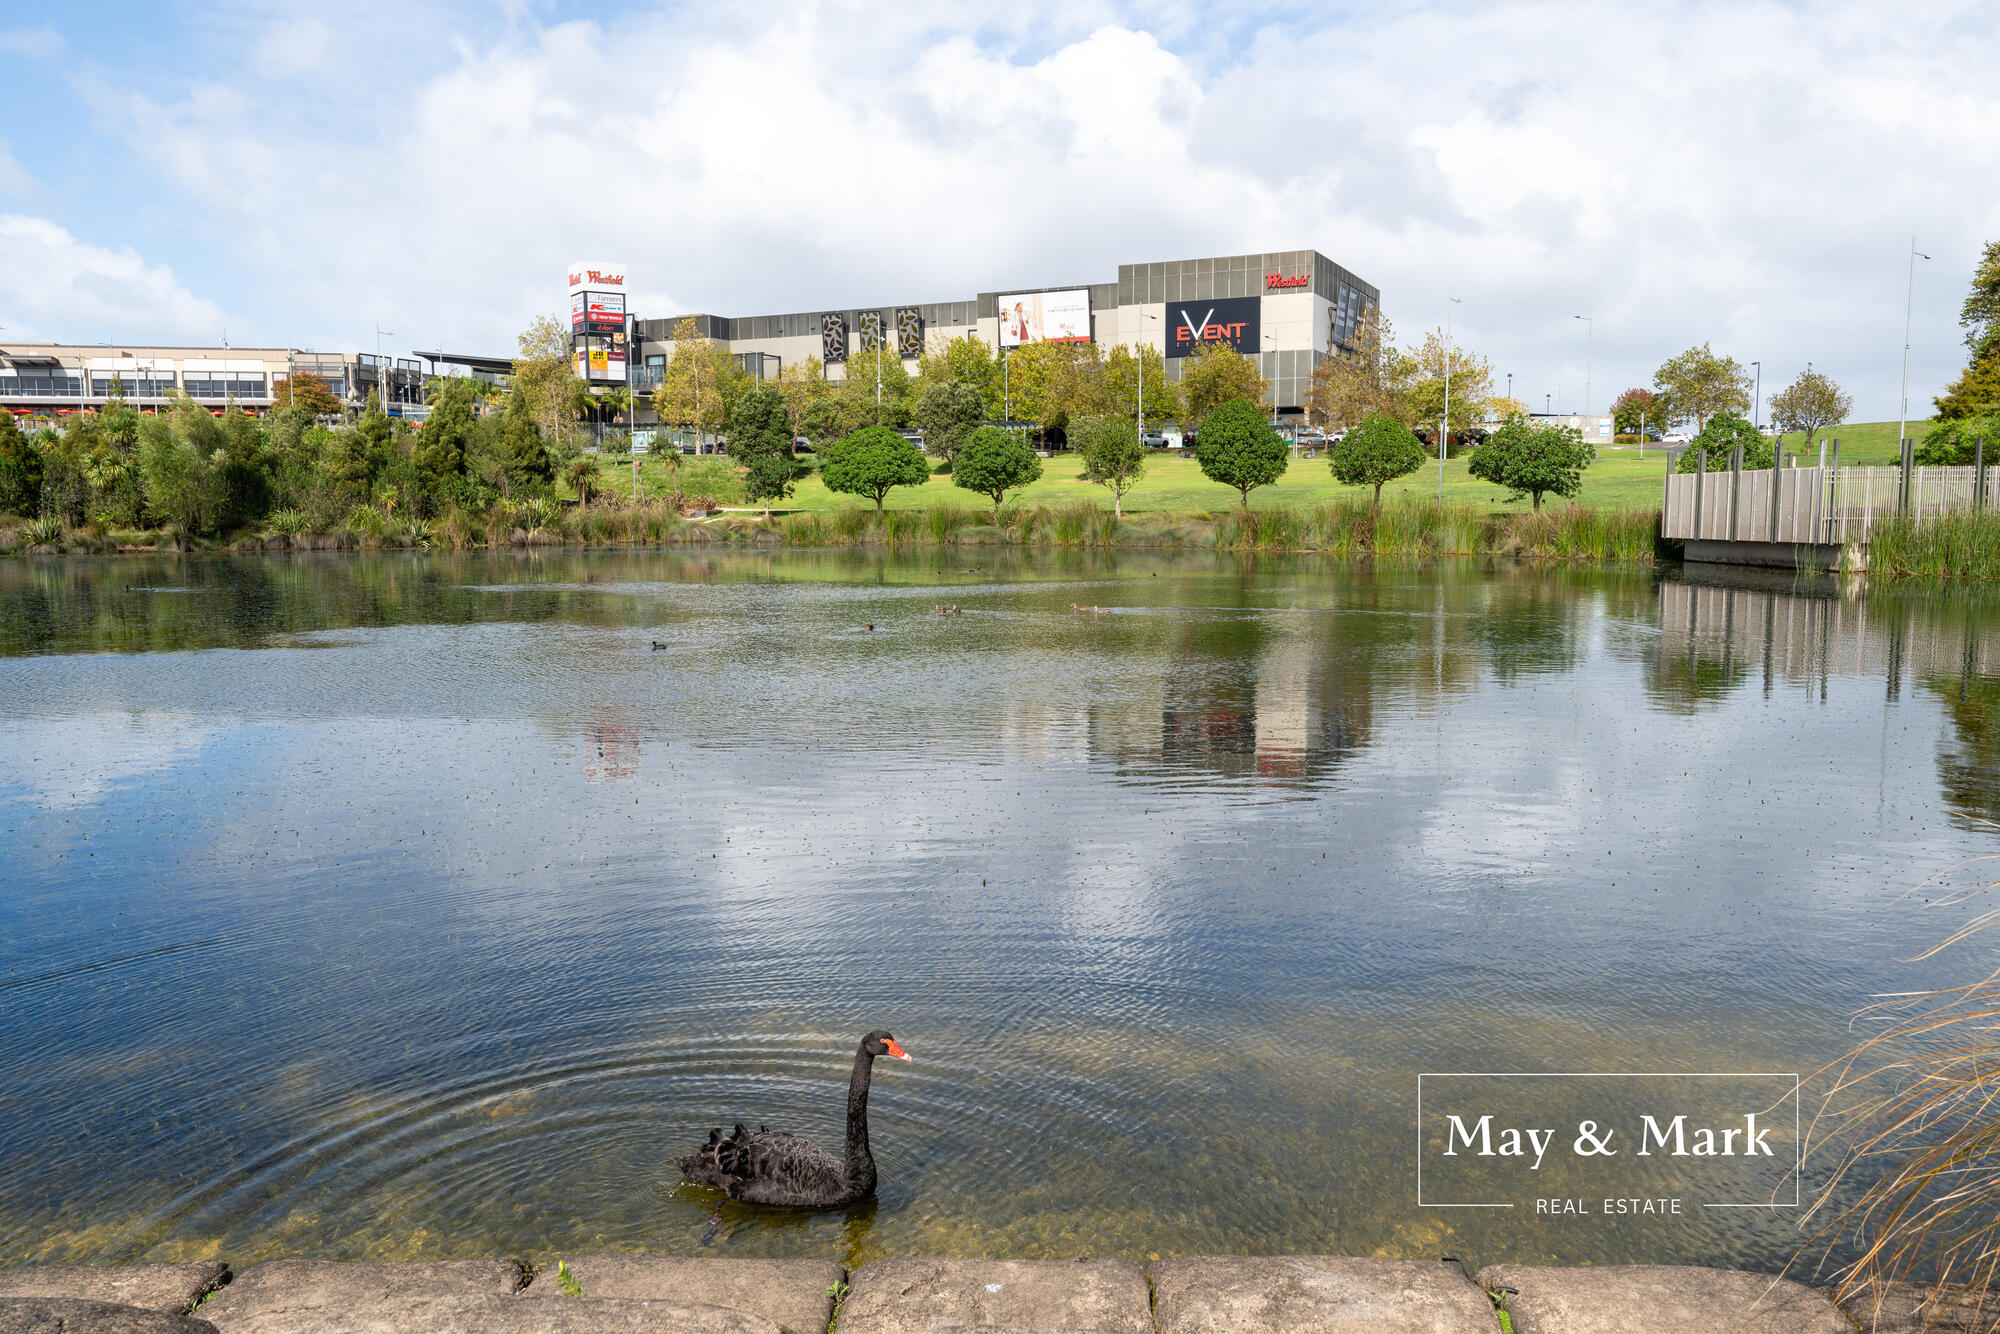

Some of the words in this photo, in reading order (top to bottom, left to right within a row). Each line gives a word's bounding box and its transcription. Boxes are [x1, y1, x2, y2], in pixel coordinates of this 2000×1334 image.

[586, 270, 624, 285] Westfield
[1266, 272, 1310, 289] Westfield
[597, 294, 622, 303] Farmers
[1176, 308, 1247, 341] EVENT
